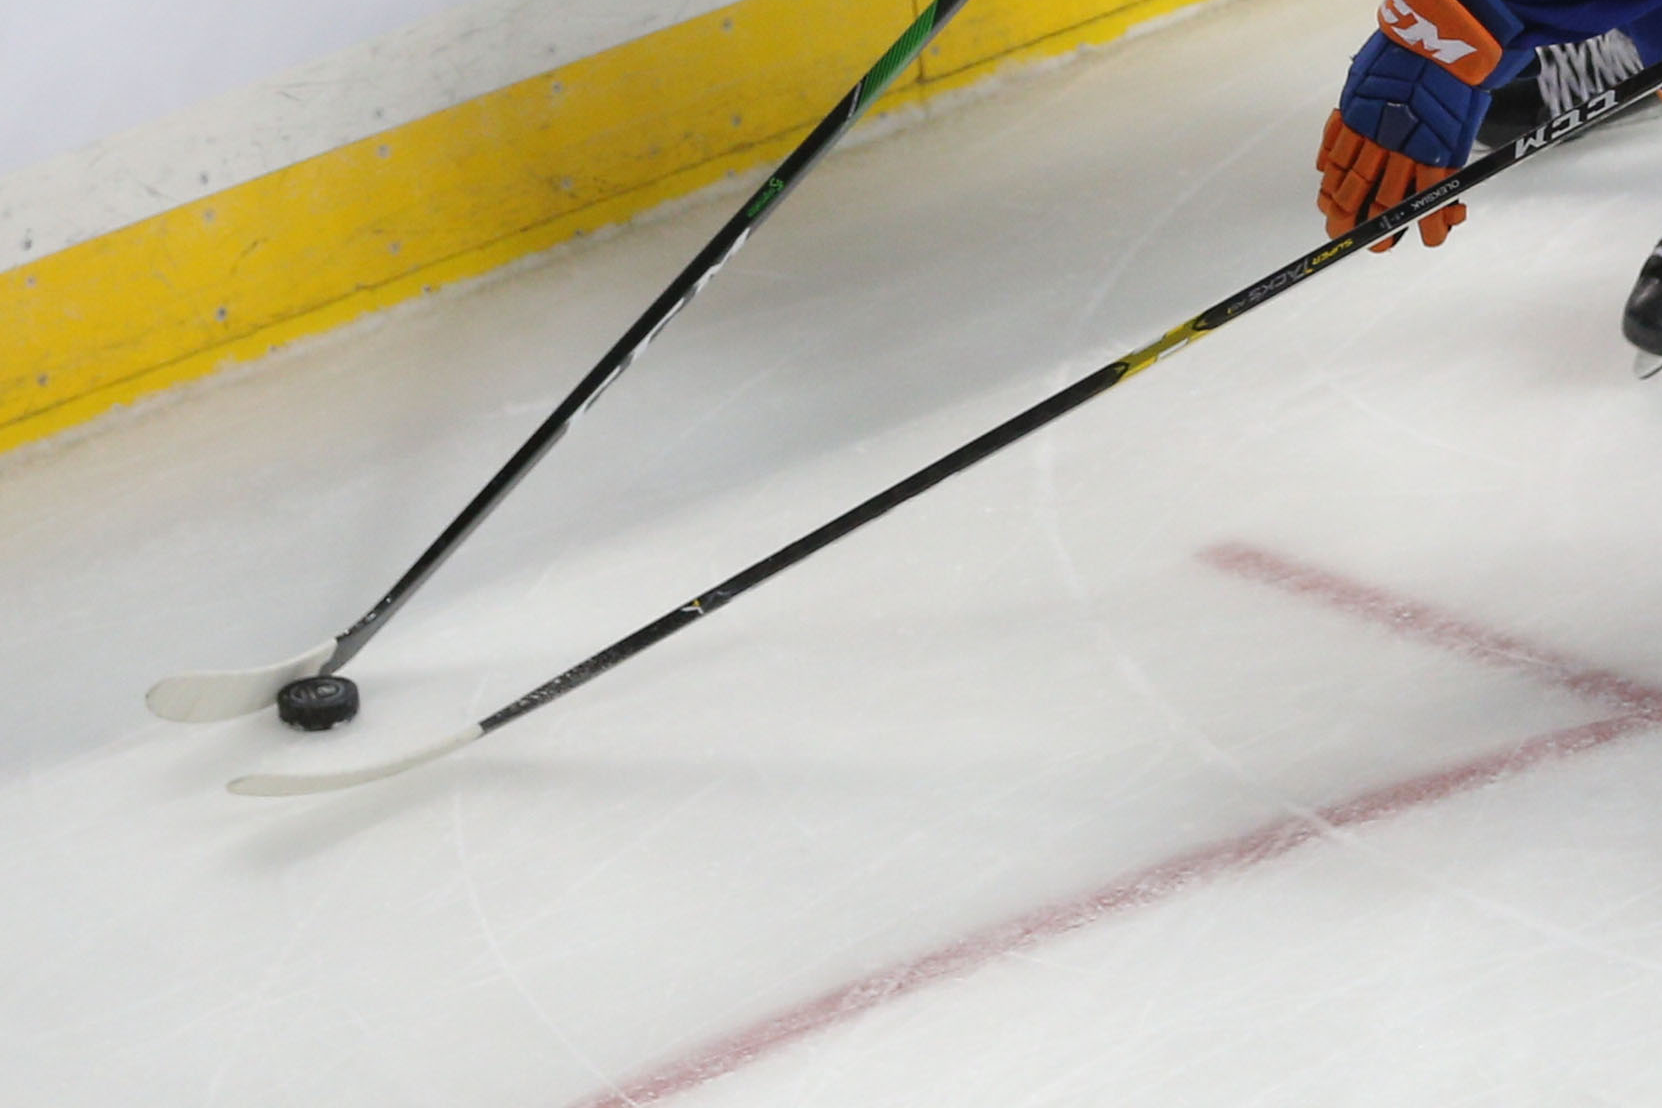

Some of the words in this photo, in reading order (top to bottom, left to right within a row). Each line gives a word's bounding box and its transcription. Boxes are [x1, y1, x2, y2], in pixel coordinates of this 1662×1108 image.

[1514, 90, 1619, 159] CCM
[1411, 179, 1461, 210] OLEKSIAK
[1312, 237, 1354, 266] SUPER
[1248, 255, 1314, 300] TACKS
